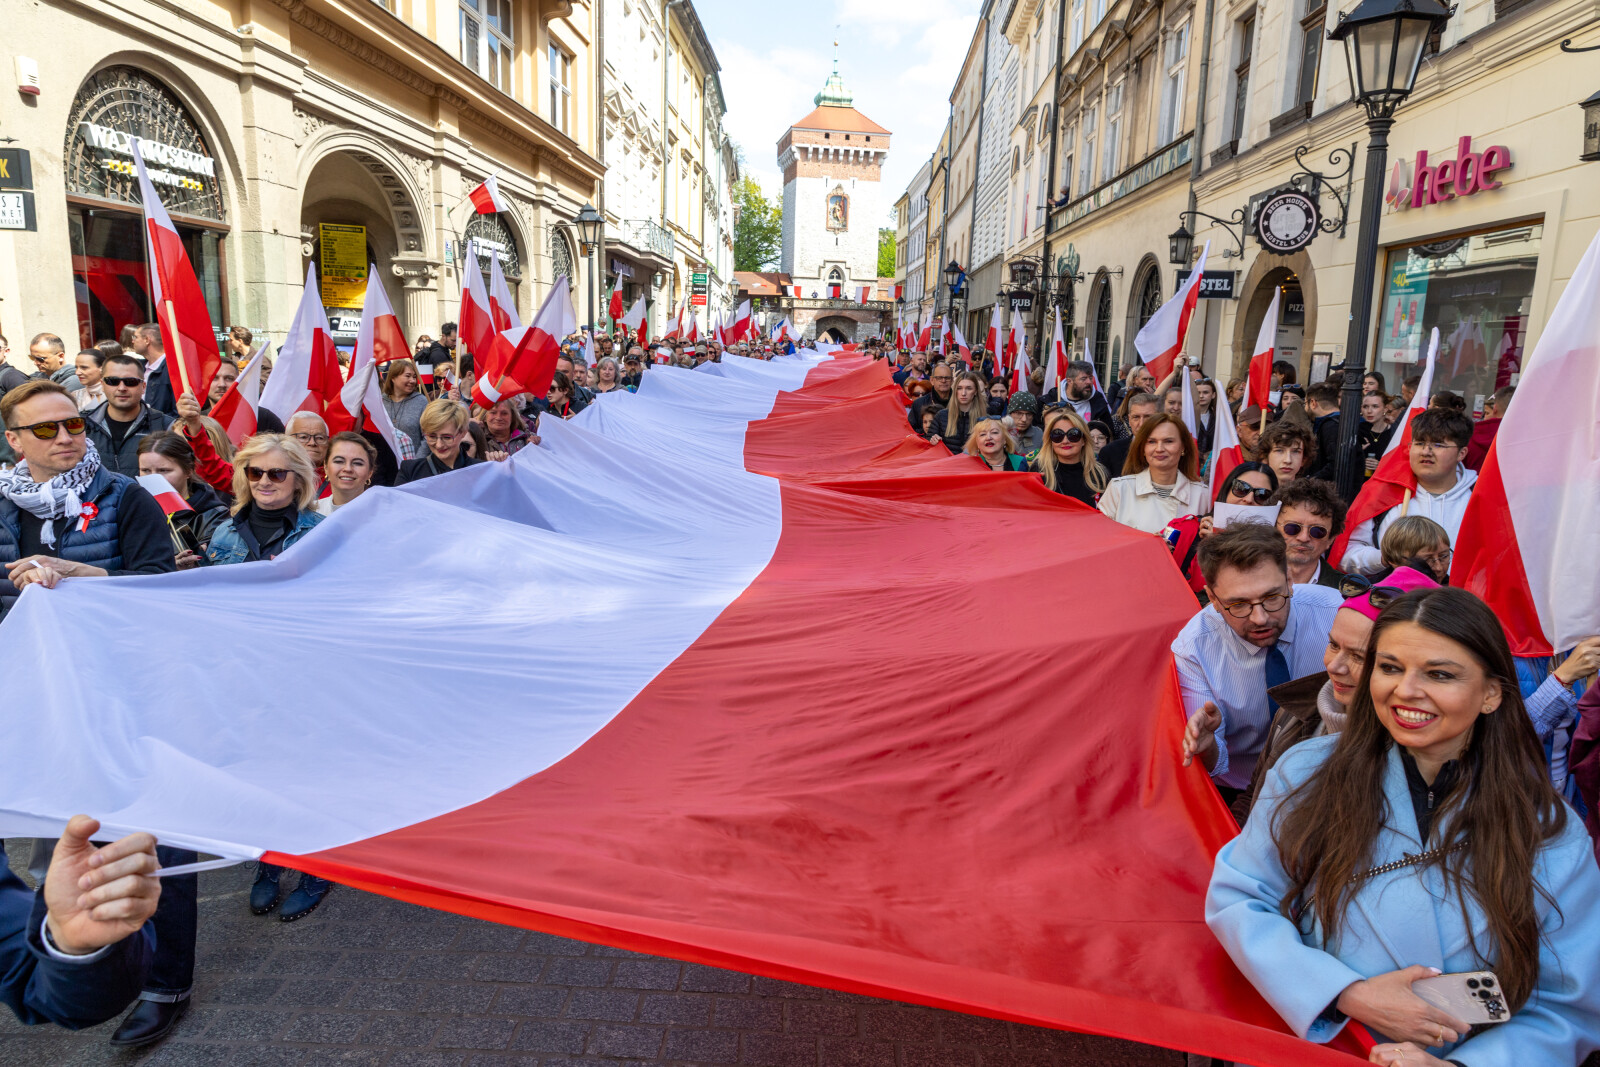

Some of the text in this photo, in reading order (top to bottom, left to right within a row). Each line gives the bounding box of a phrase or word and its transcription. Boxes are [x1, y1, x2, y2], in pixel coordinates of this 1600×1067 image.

[80, 121, 215, 178] WAX MUSEUM
[1411, 136, 1511, 209] hebe
[1267, 199, 1285, 215] BEER
[1286, 197, 1308, 211] HOUSE
[1265, 231, 1288, 247] HOSTEL
[1296, 230, 1309, 242] PUB
[1179, 278, 1231, 291] HSTEL
[1011, 298, 1031, 307] PUB
[342, 320, 361, 328] ATM
